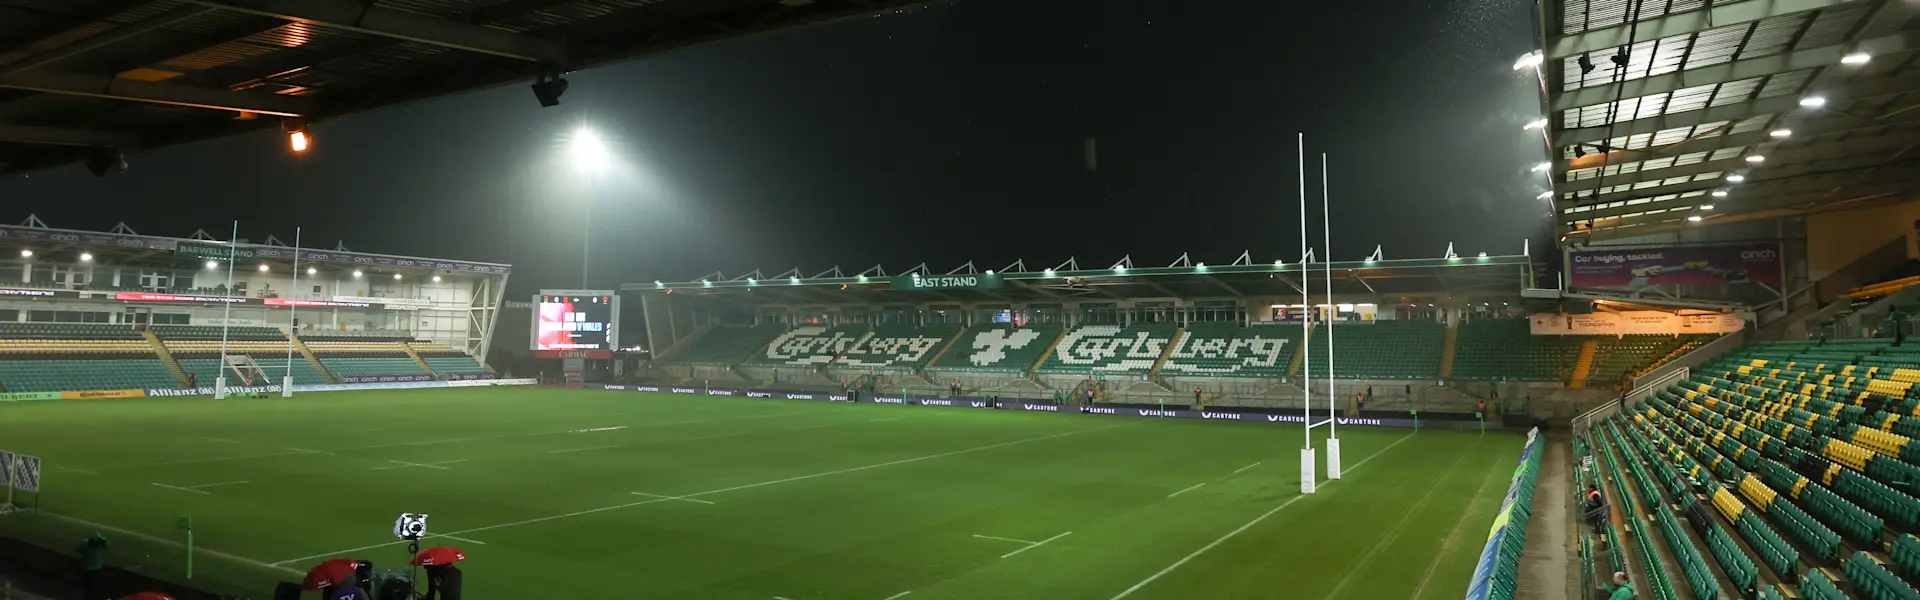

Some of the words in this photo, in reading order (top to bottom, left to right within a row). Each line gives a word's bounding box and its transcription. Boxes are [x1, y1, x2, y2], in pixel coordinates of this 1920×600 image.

[50, 233, 79, 242] cinch
[117, 238, 144, 247] cinch
[180, 246, 223, 256] BARWELL
[224, 249, 253, 258] SAND
[259, 249, 281, 257] cinch
[308, 252, 329, 260] cinch
[1740, 248, 1776, 259] cinch
[397, 259, 415, 267] cinch
[1575, 255, 1591, 263] Car
[1594, 254, 1626, 264] buying,
[1627, 253, 1665, 261] tackled.
[914, 278, 940, 288] EAST
[941, 277, 977, 287] STAND
[583, 322, 603, 331] WALES
[766, 327, 942, 367] Carlsberg
[1056, 325, 1289, 372] Carlsberg
[150, 388, 198, 397] Allianz
[224, 386, 266, 394] Allianz
[1033, 404, 1058, 412] CASTORE
[1150, 409, 1176, 417] CASORE
[1212, 412, 1241, 420] CASTORE
[1279, 415, 1305, 423] CASTOR
[1350, 418, 1381, 426] CASTORE
